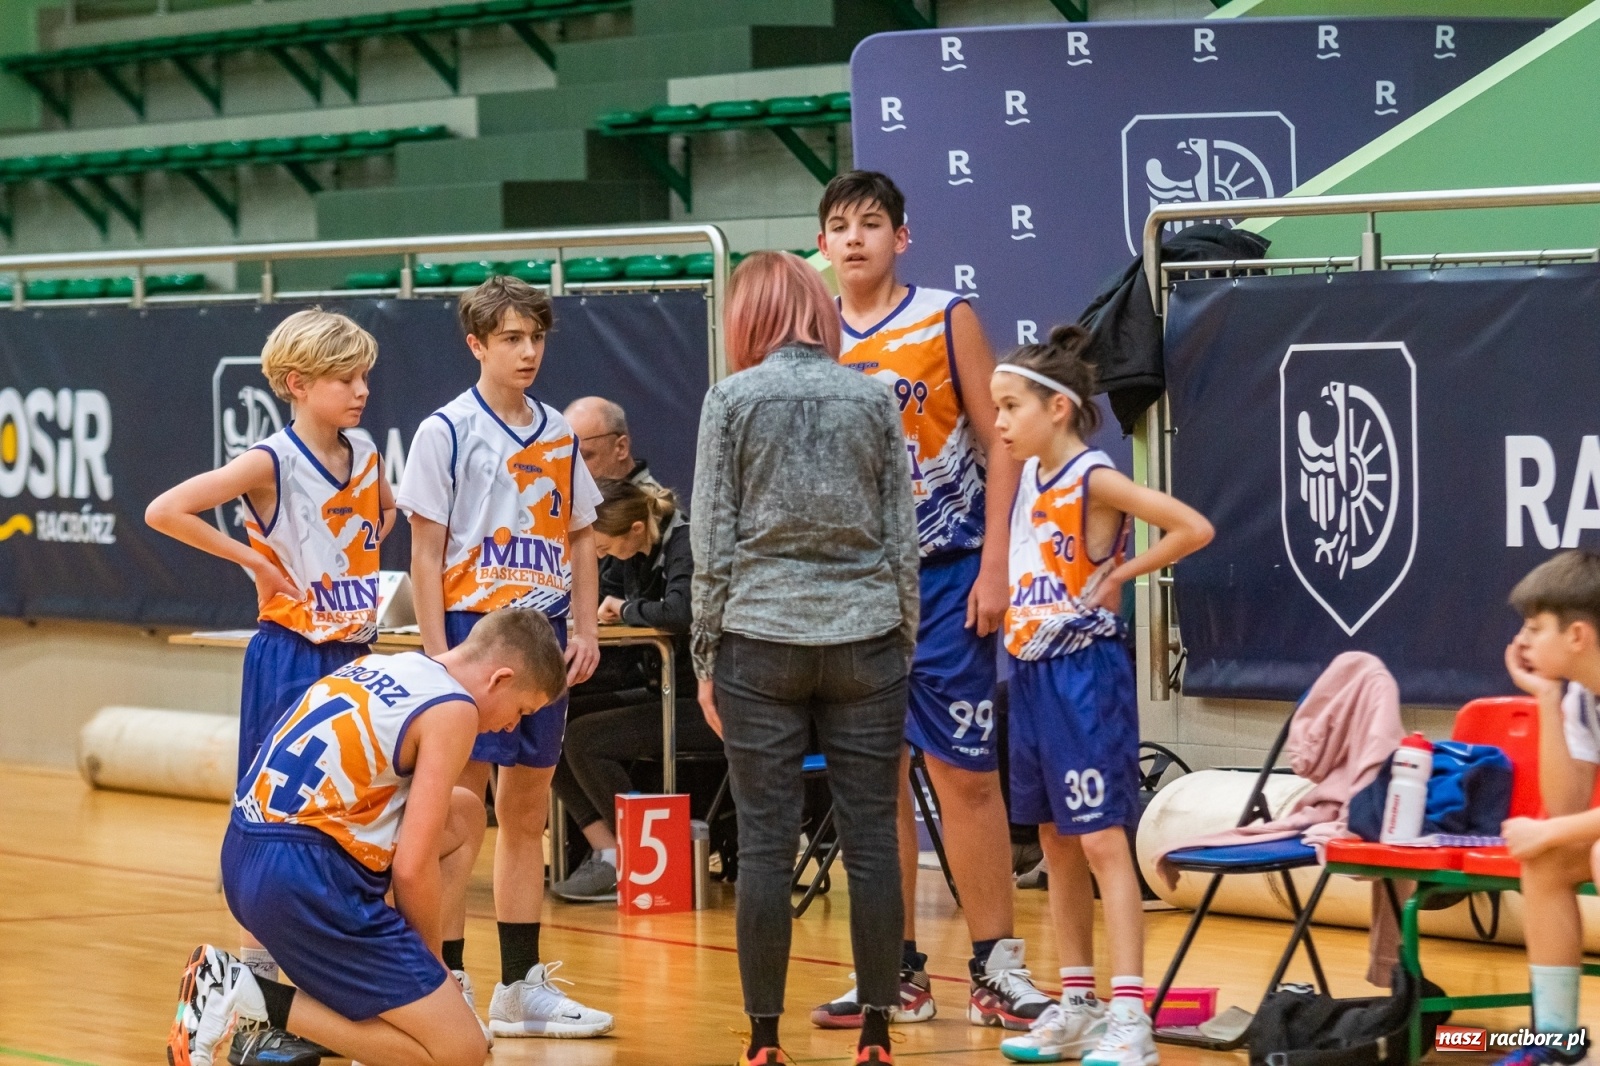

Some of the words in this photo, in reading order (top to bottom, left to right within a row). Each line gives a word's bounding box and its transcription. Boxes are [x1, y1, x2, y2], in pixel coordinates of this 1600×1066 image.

[941, 36, 965, 61] R
[1067, 31, 1091, 56] R
[1194, 28, 1217, 52] R
[1318, 25, 1339, 49] R
[1435, 25, 1455, 49] R
[1005, 90, 1028, 115] R
[1375, 80, 1397, 105] R
[881, 97, 904, 122] R
[948, 149, 971, 175] R
[1011, 204, 1034, 230] R
[954, 264, 977, 290] R
[1017, 319, 1039, 345] R
[894, 378, 928, 413] 99
[481, 535, 563, 578] MINI
[479, 566, 566, 590] BASKETBALL
[949, 700, 994, 742] 99
[1064, 768, 1105, 811] 30
[629, 808, 670, 886] 5
